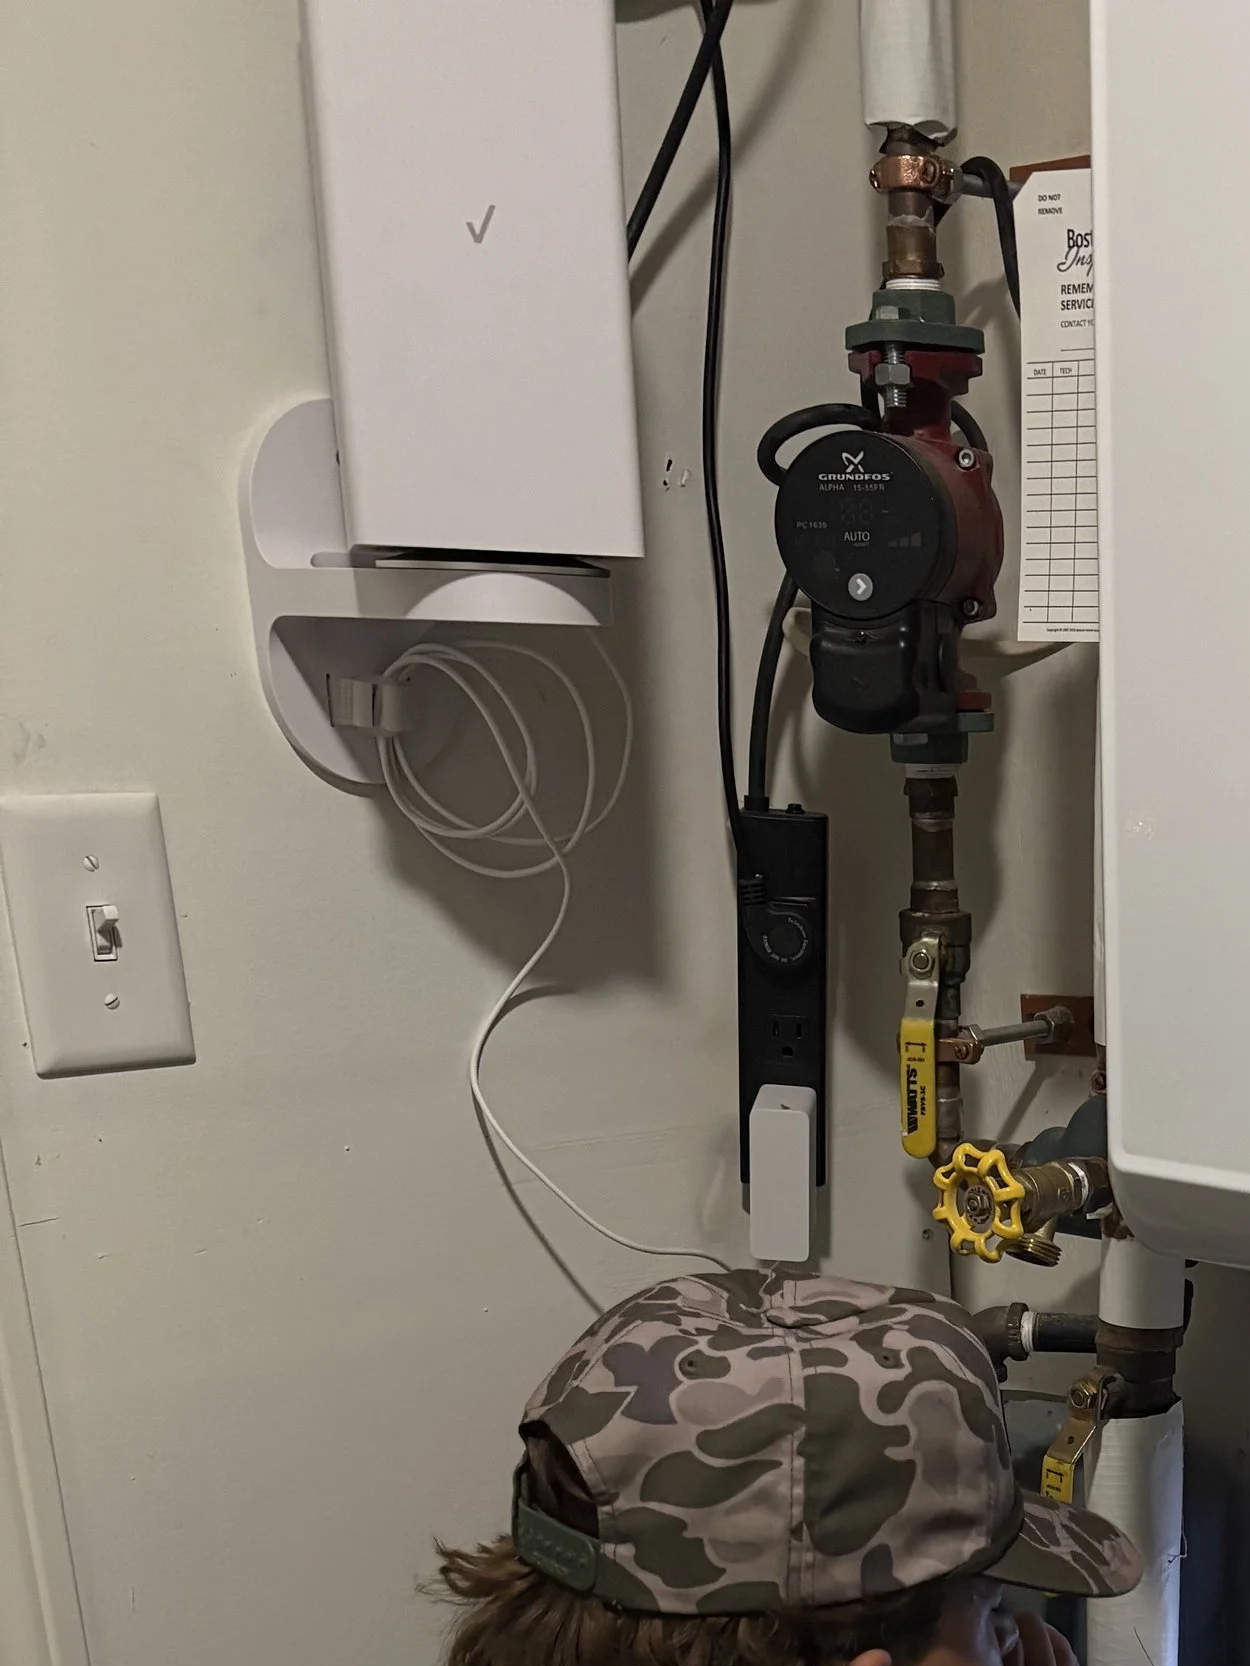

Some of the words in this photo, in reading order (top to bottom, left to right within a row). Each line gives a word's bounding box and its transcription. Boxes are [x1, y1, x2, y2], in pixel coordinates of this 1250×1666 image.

[1038, 194, 1047, 202] DO
[1048, 193, 1061, 201] NOT
[1038, 207, 1062, 215] REMOVE
[1060, 320, 1087, 328] CONTACT
[1033, 367, 1047, 376] DATE
[1059, 366, 1072, 375] TECH
[818, 473, 891, 481] GRUNDFOS
[819, 483, 845, 491] ALPHA
[844, 531, 870, 542] AUTO
[907, 1066, 918, 1135] WATTS
